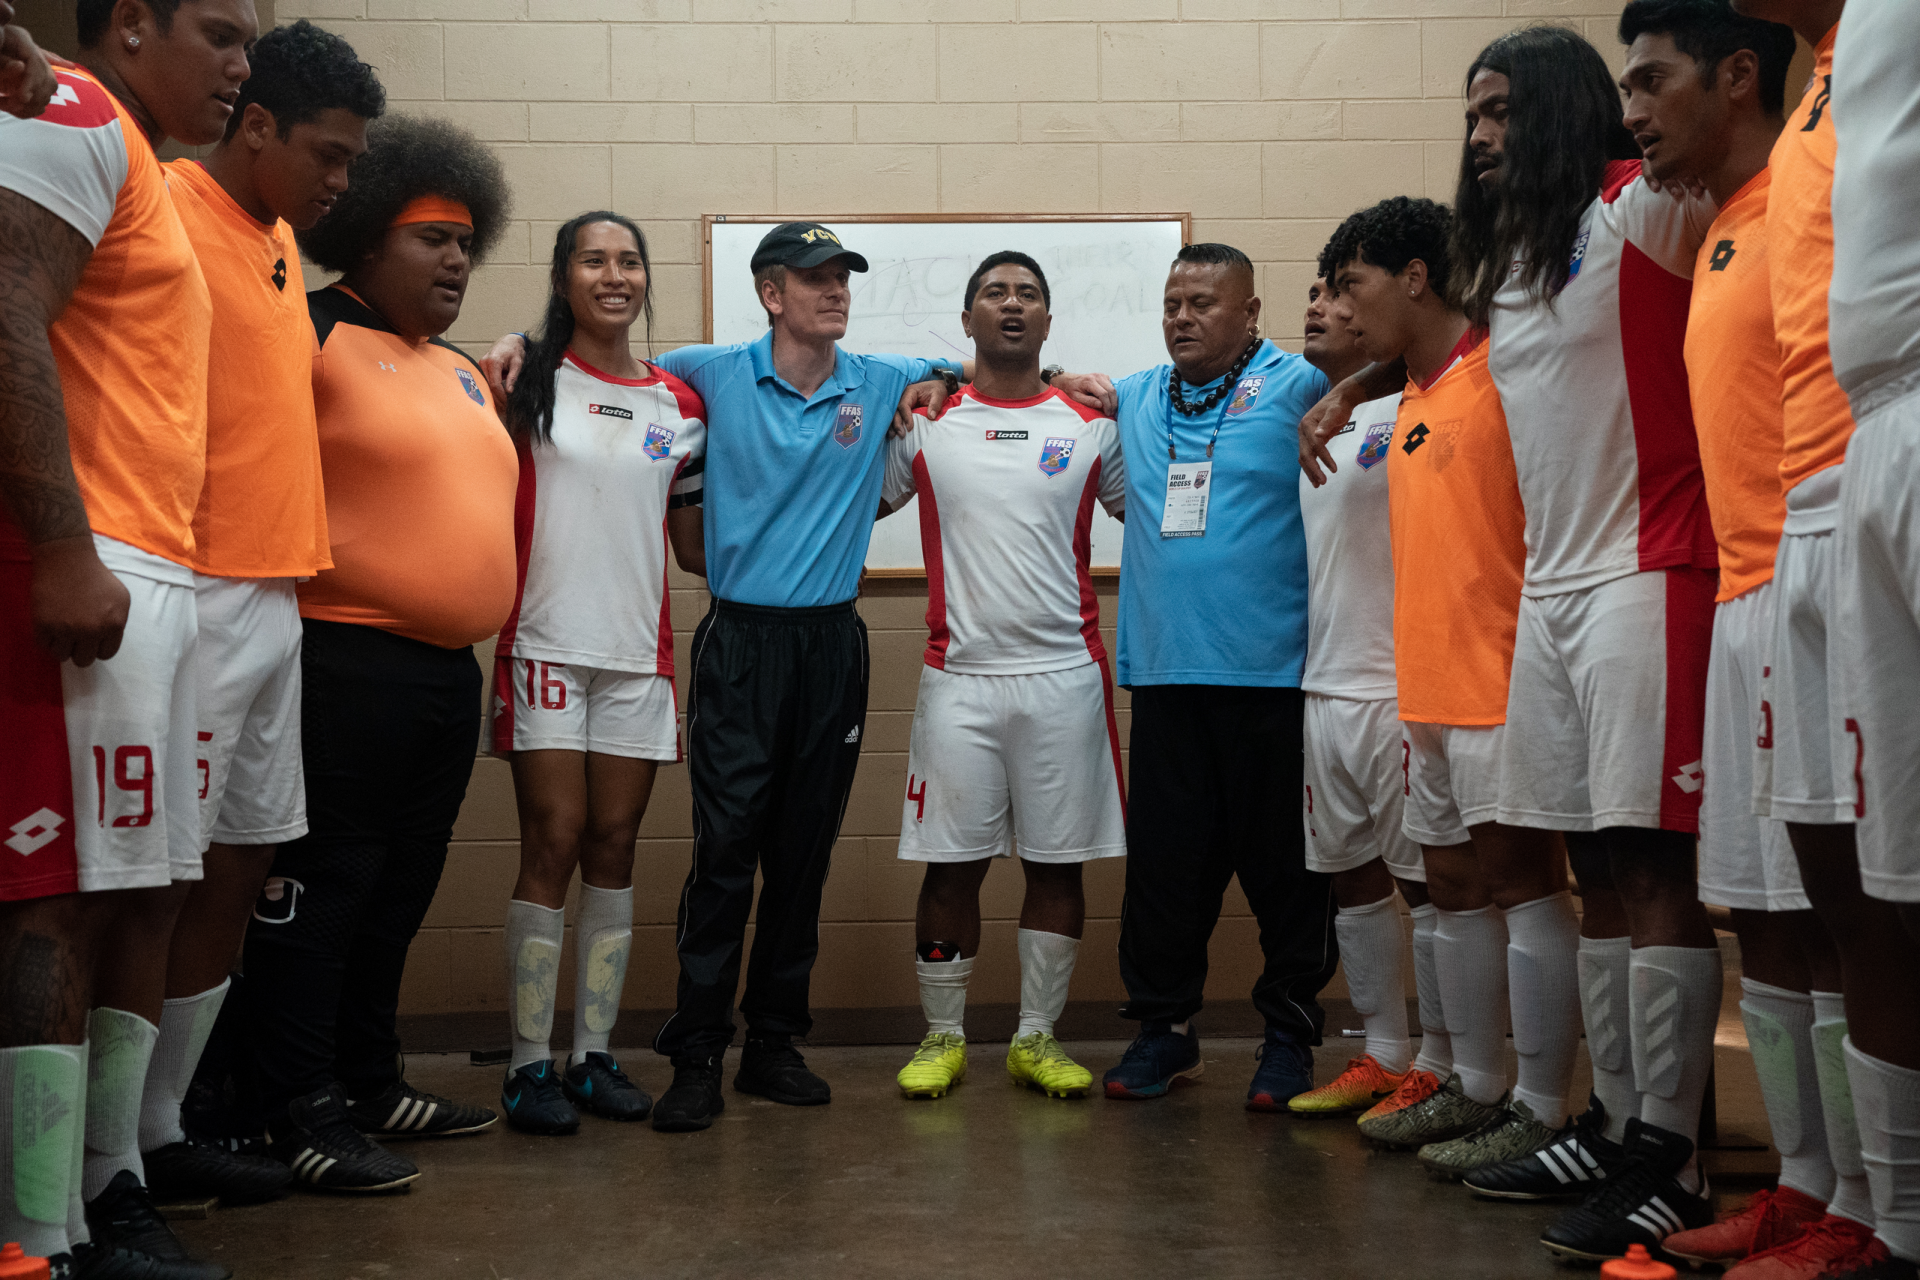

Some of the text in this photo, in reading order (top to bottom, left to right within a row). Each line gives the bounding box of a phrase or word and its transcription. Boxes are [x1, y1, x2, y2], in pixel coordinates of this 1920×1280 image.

[866, 255, 972, 311] TAC
[1238, 378, 1262, 388] FAS
[840, 406, 862, 416] FFAS
[649, 425, 673, 440] FFAS
[1368, 424, 1395, 436] FFAS
[1046, 440, 1073, 448] FFAS
[525, 659, 567, 710] 16
[93, 745, 154, 828] 19
[907, 773, 926, 824] 4
